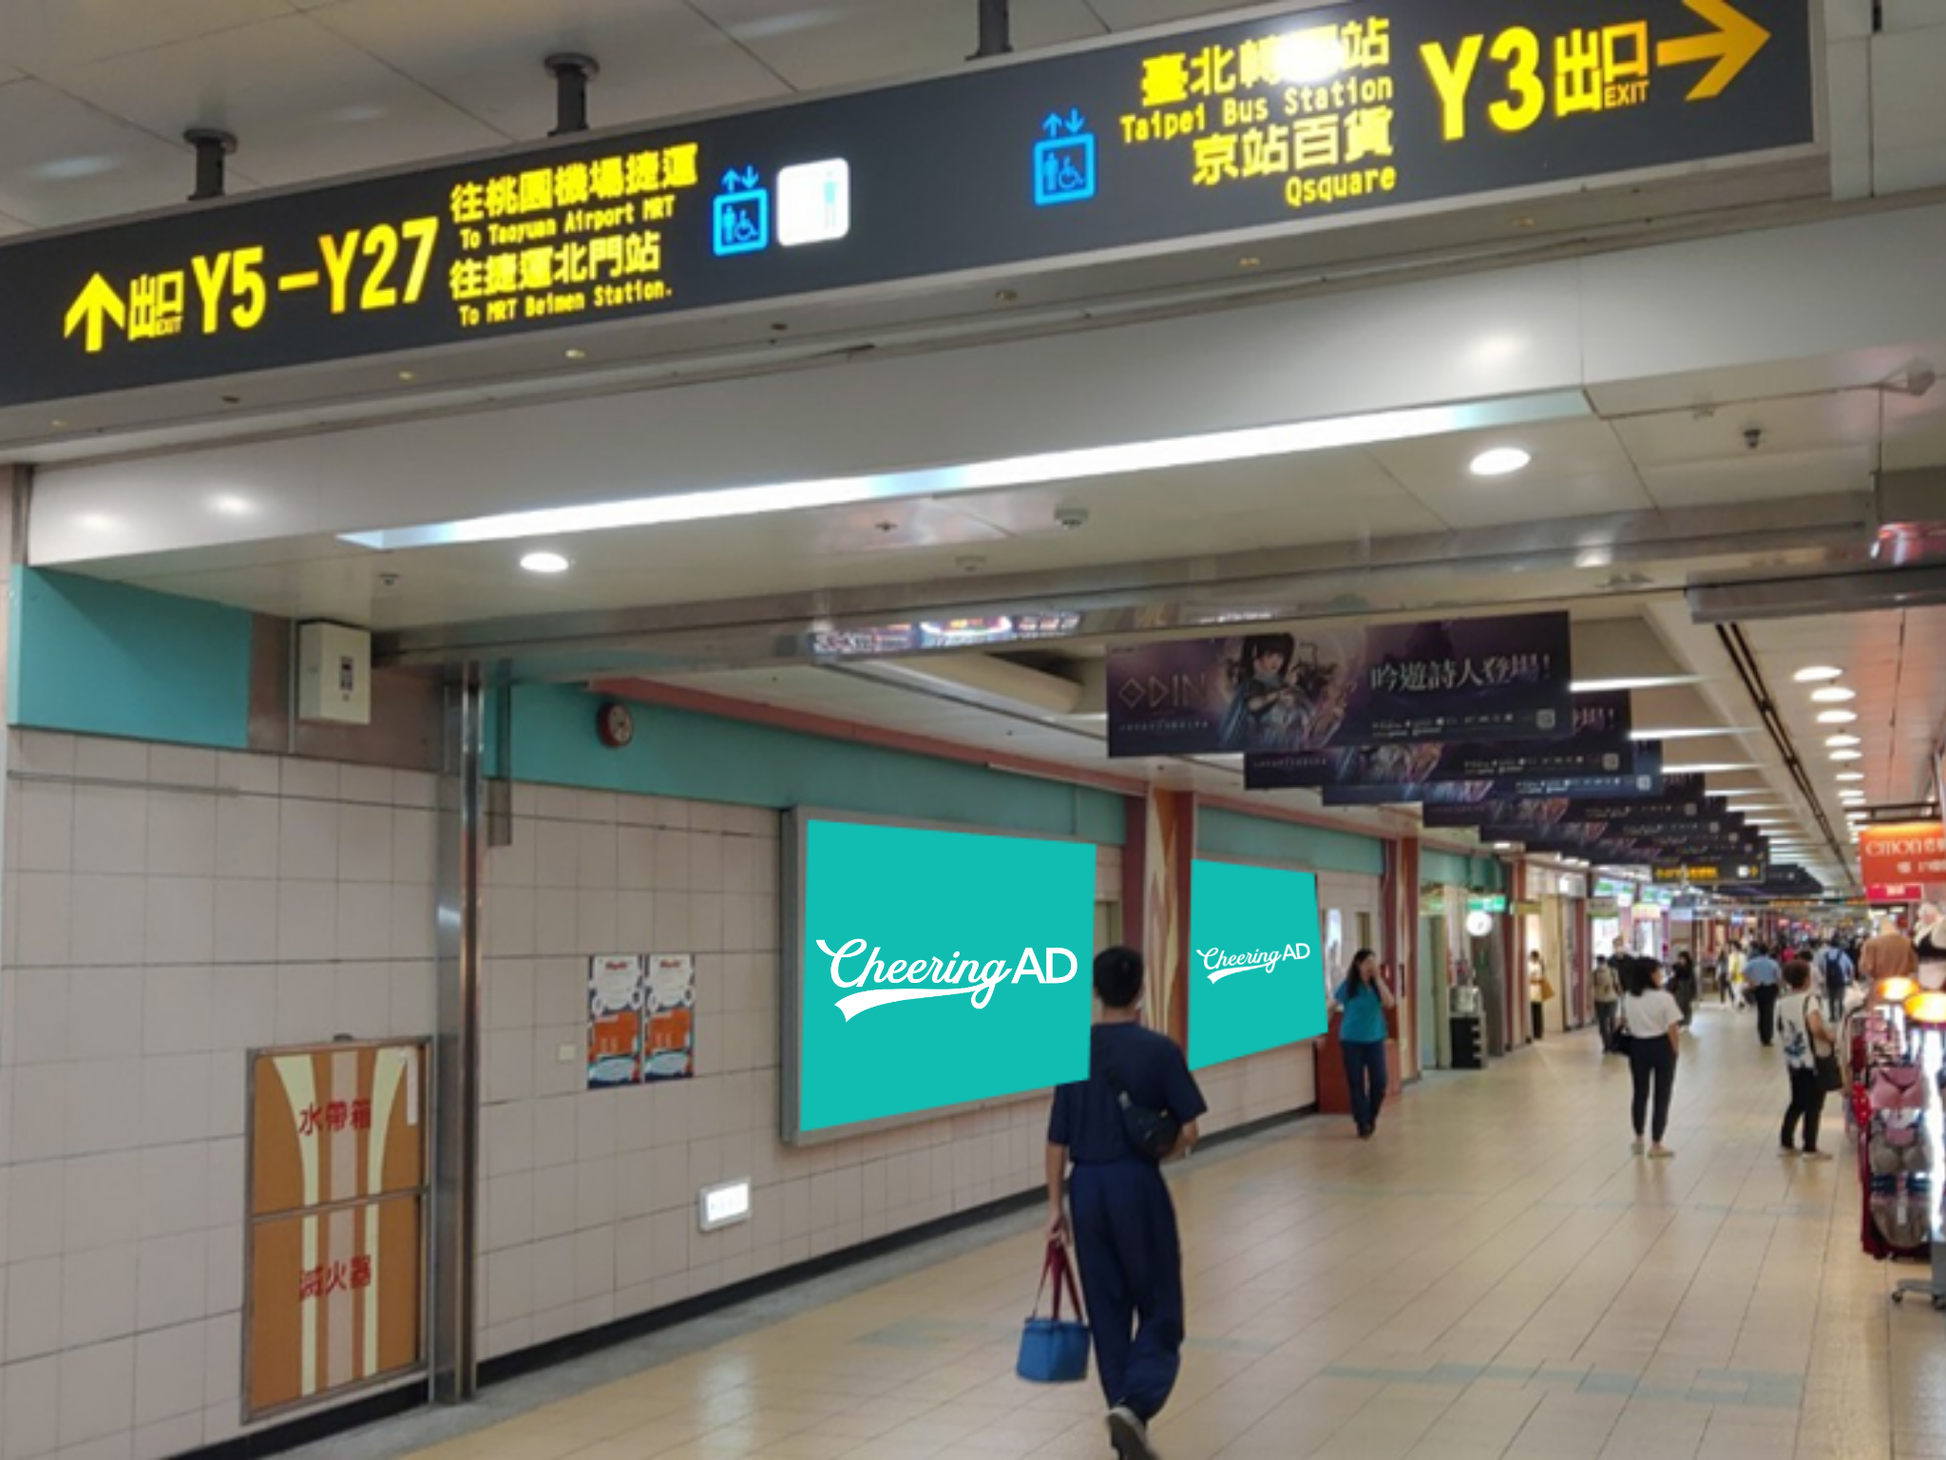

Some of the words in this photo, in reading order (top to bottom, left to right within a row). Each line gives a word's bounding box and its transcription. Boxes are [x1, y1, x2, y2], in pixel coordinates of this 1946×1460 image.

[1141, 17, 1390, 106] 臺北轉站
[1419, 26, 1546, 142] Y3
[1554, 19, 1648, 117] 出口
[1120, 102, 1206, 143] Taipei
[1222, 96, 1268, 127] Bus
[1284, 75, 1393, 115] Station
[1603, 79, 1650, 109] EXIT
[1192, 105, 1394, 185] 京站百貨
[1284, 166, 1397, 207] Qsquare
[460, 227, 481, 249] To
[564, 202, 635, 234] Airport
[642, 194, 676, 221] MRT
[129, 269, 185, 341] 出口
[459, 304, 480, 326] To
[486, 298, 518, 323] MRT
[1118, 671, 1207, 710] ODIN
[298, 1099, 373, 1136] 水帶箱
[298, 1254, 372, 1302] 滅火器
